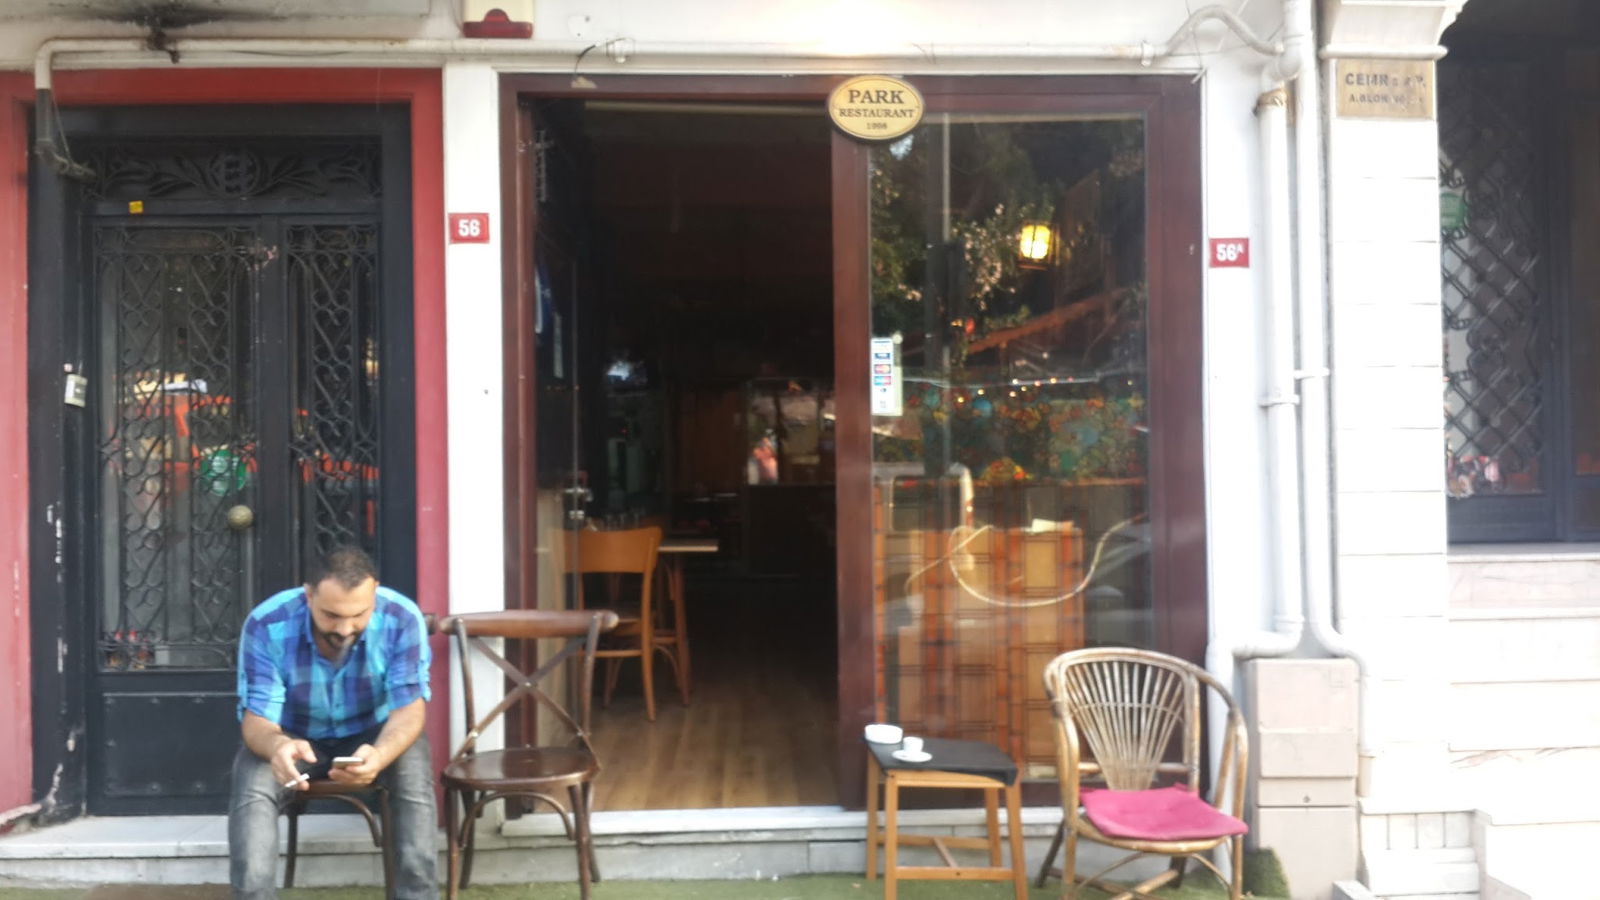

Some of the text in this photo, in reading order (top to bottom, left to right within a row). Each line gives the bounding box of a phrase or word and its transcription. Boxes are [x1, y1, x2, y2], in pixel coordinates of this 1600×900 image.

[848, 89, 904, 104] PARK
[839, 108, 915, 118] RESTAURANT
[458, 219, 481, 237] 56
